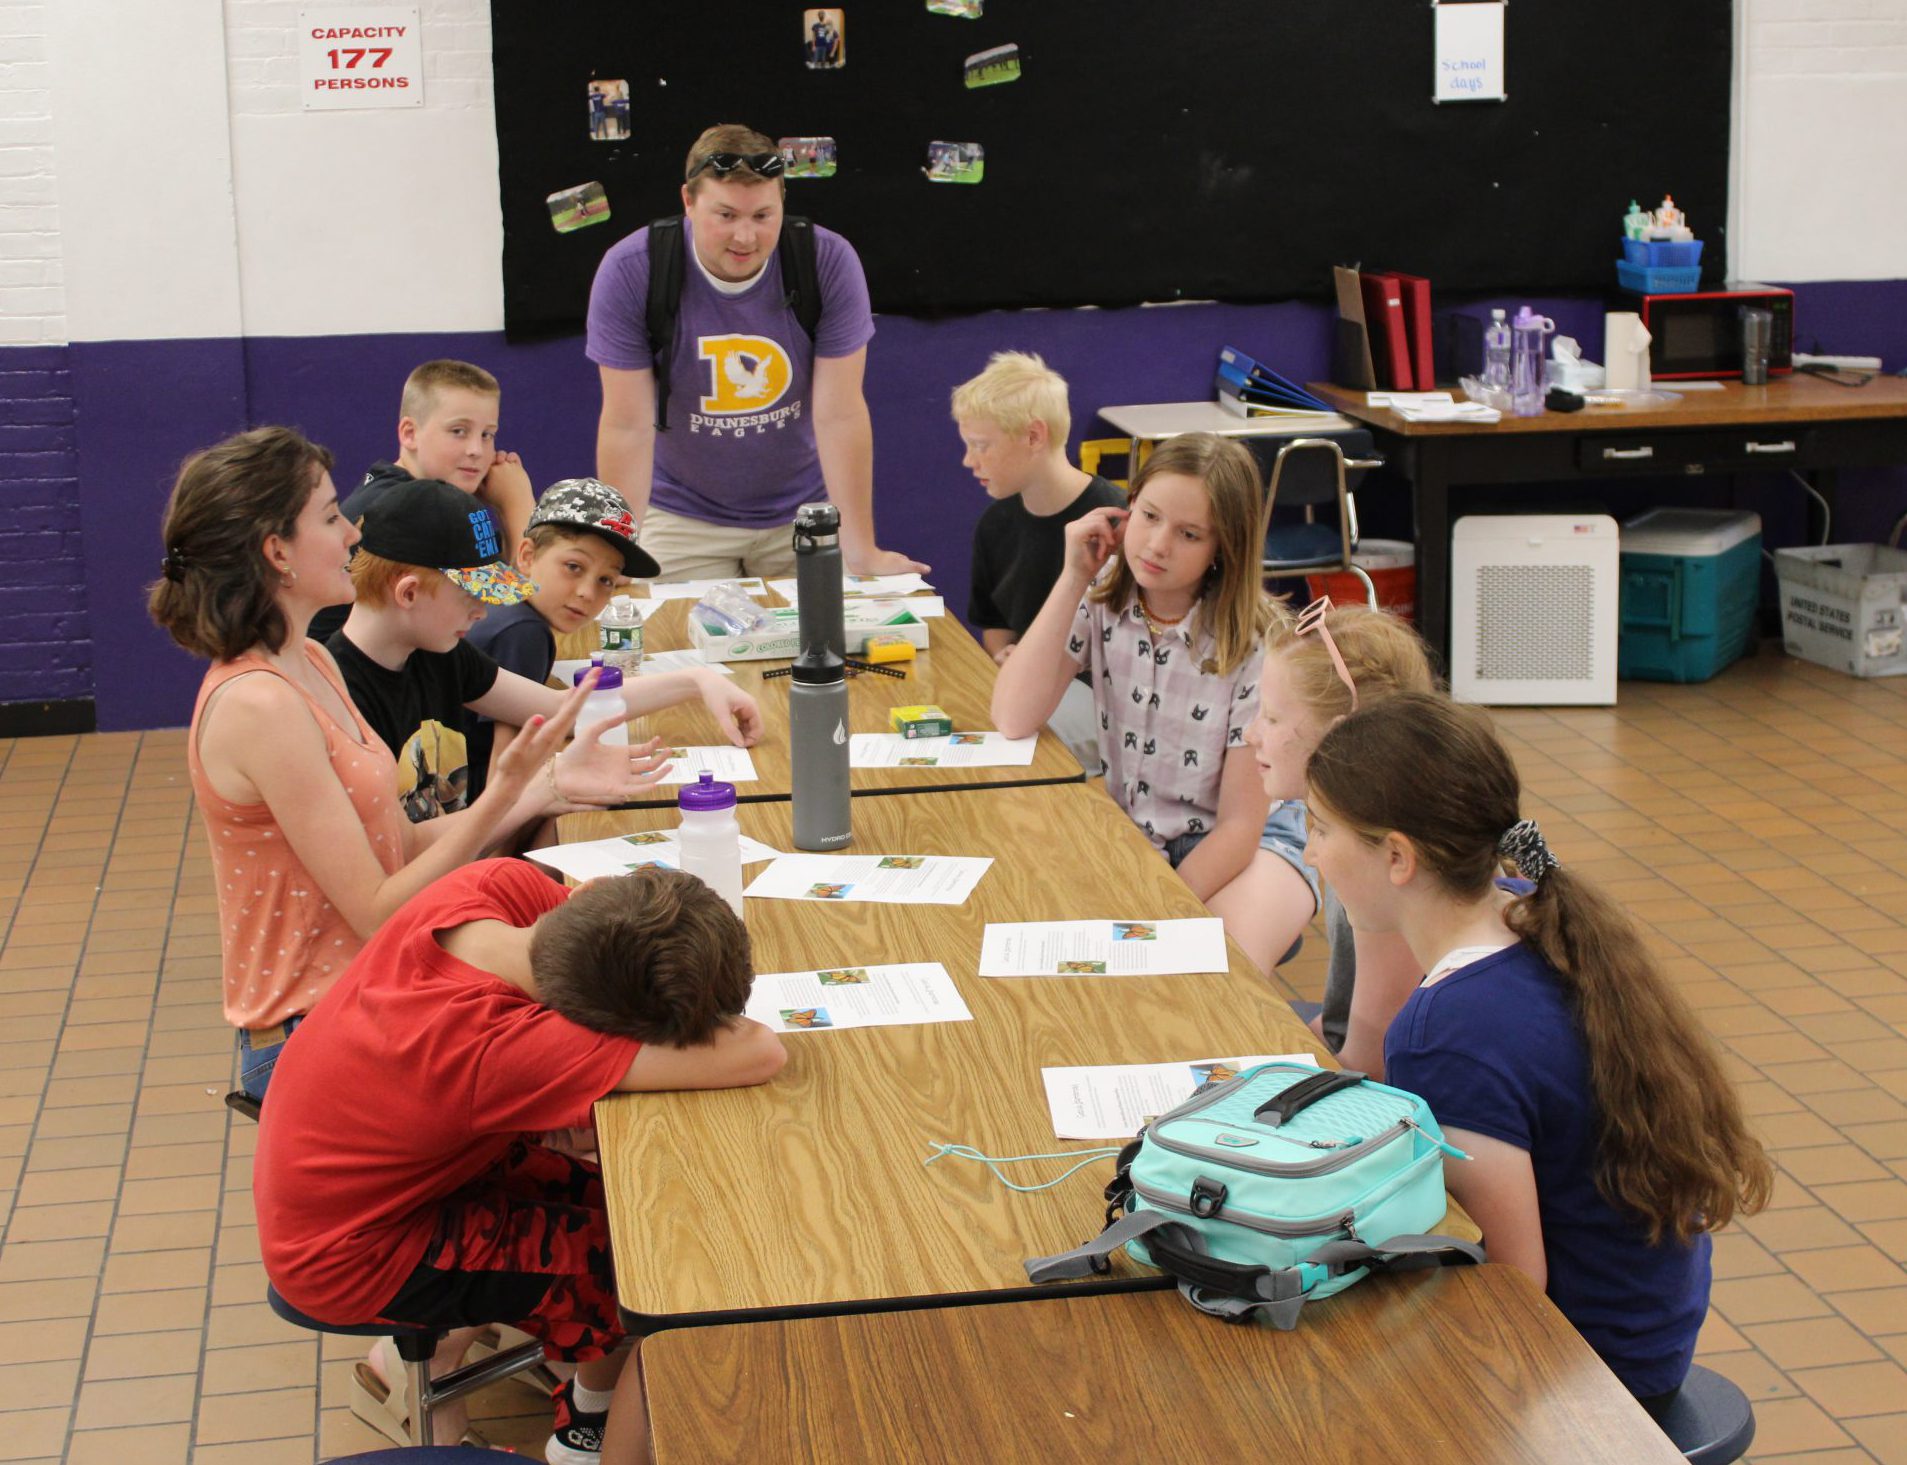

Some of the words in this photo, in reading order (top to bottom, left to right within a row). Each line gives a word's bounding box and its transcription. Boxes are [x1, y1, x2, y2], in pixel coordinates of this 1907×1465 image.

[311, 26, 406, 40] CAPACITY
[327, 47, 393, 70] 177
[314, 76, 410, 91] PERSONS
[1450, 77, 1484, 92] days
[689, 400, 801, 429] DUANESBURG
[689, 411, 801, 438] EAGLES
[1790, 596, 1818, 614] UNITED
[1819, 604, 1851, 623] STATES
[1787, 610, 1817, 630] POSTAL
[1819, 620, 1853, 641] SERVICE
[821, 834, 846, 844] HYDRO
